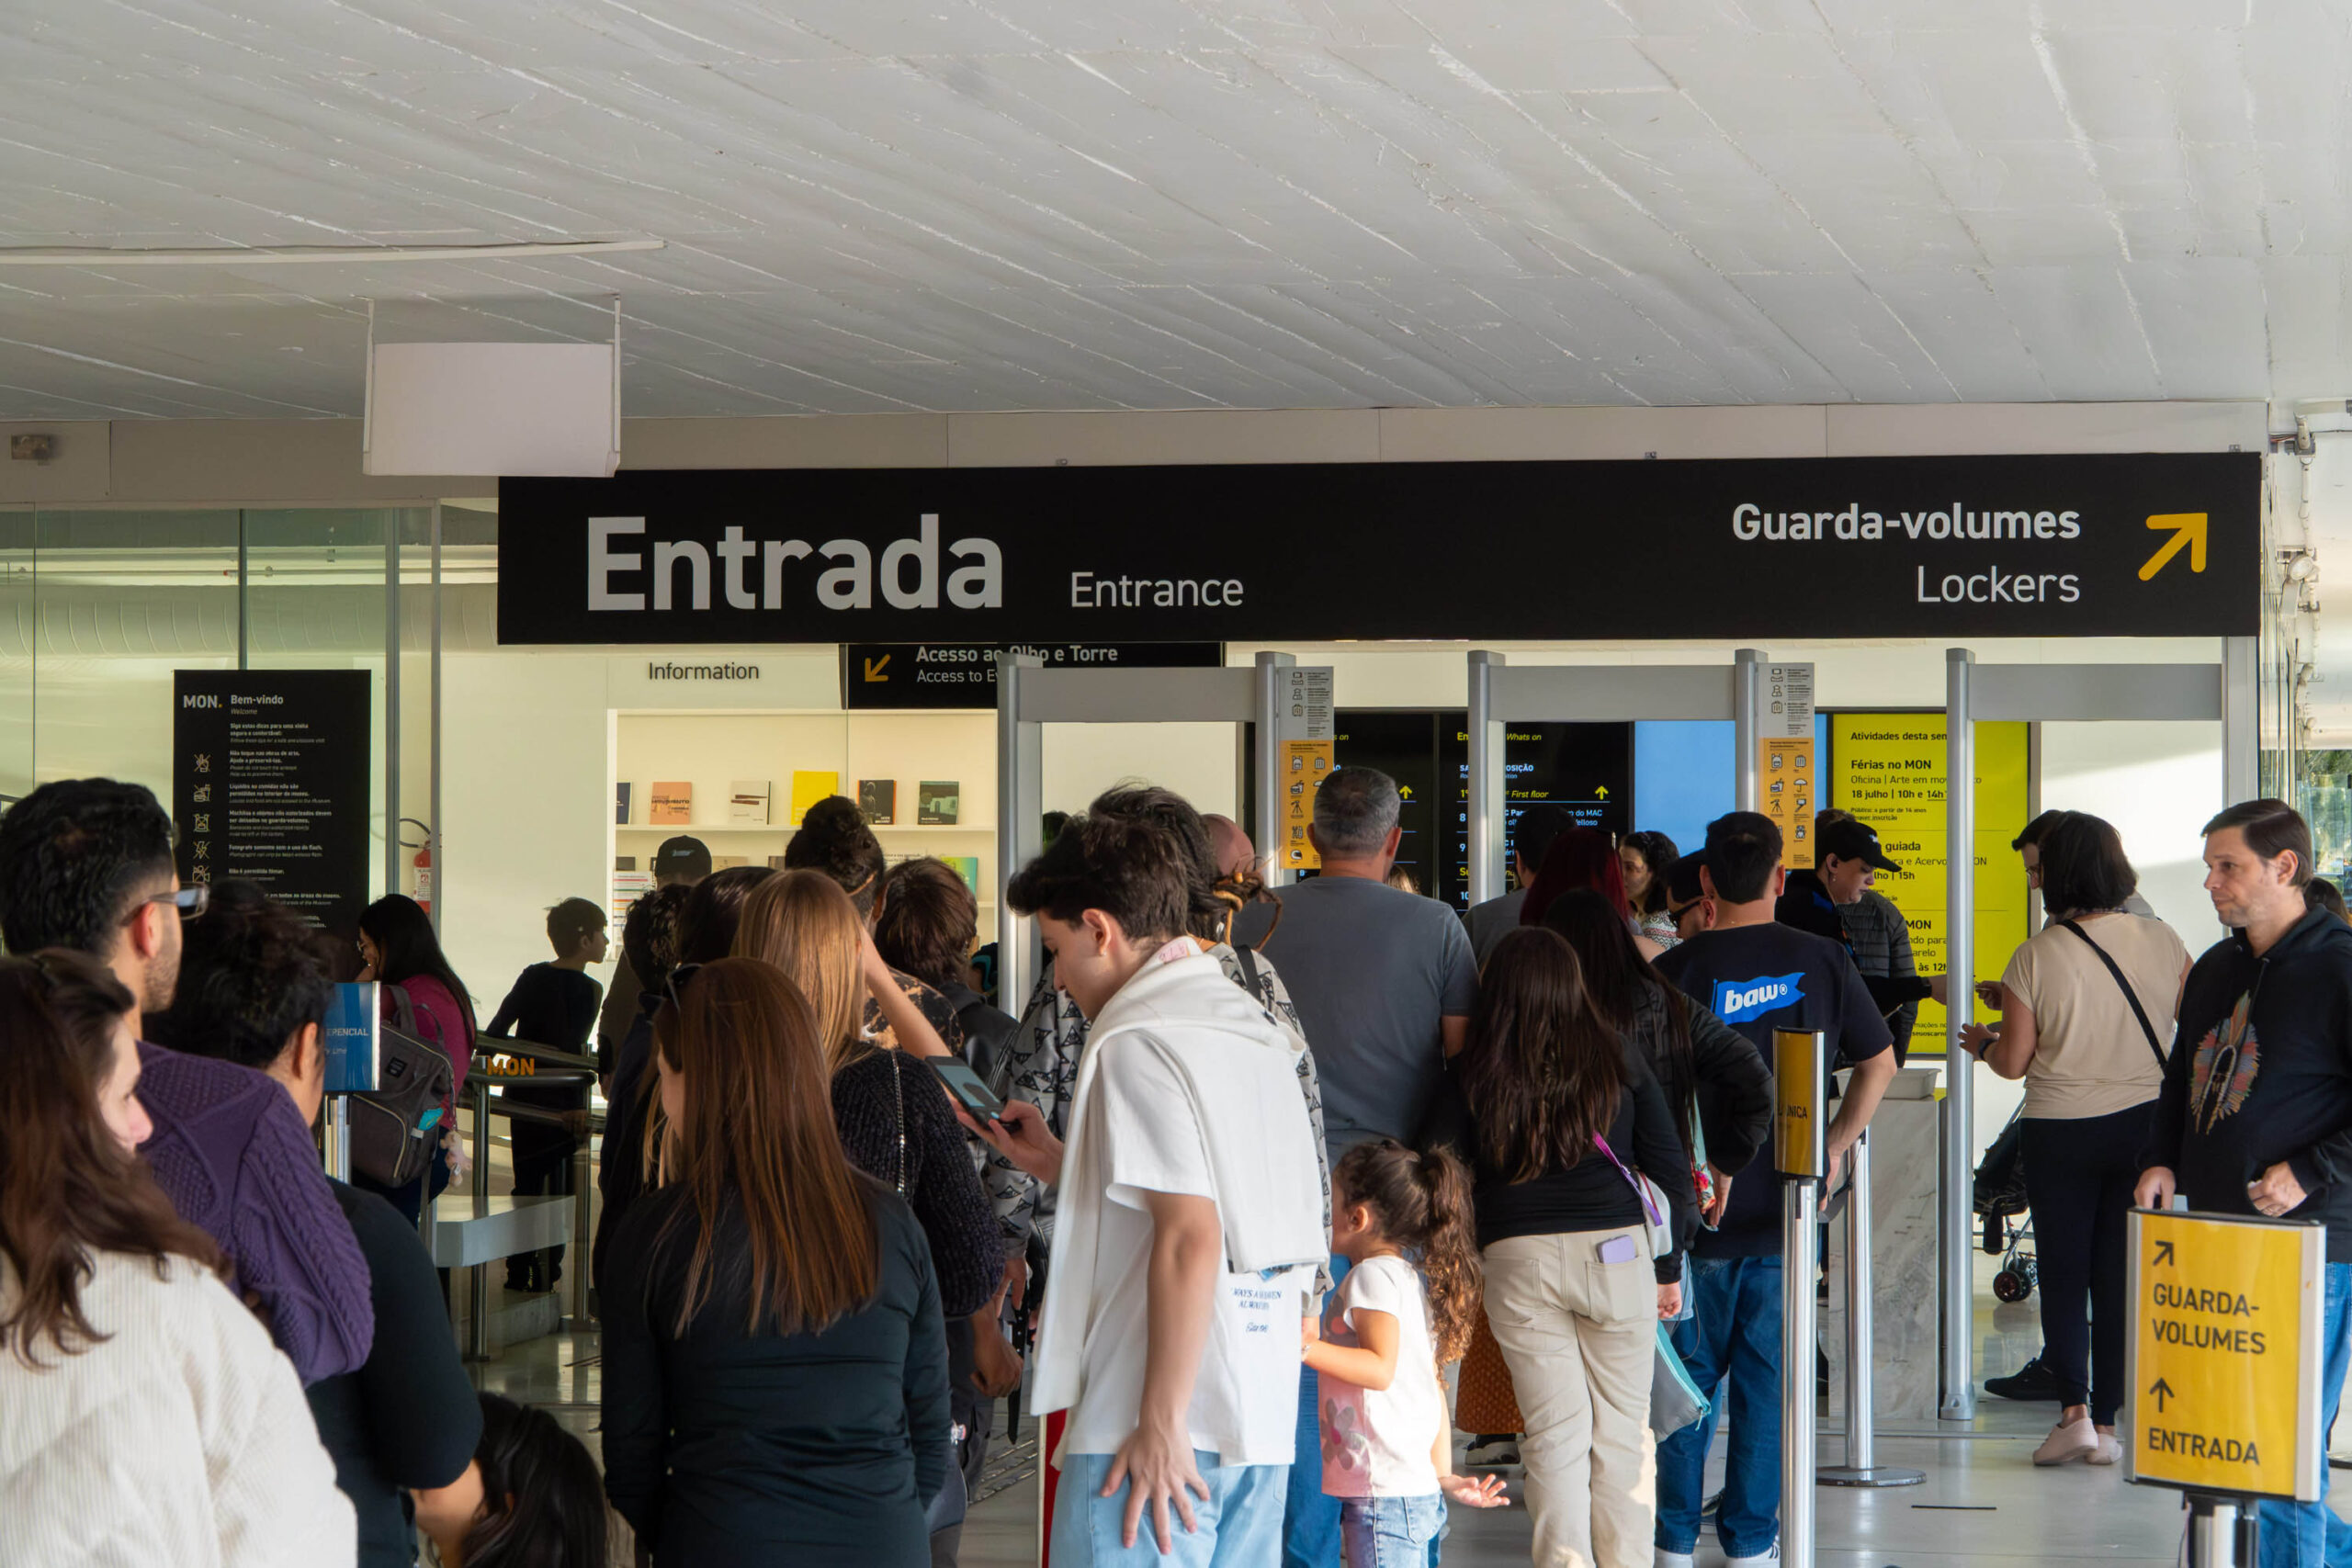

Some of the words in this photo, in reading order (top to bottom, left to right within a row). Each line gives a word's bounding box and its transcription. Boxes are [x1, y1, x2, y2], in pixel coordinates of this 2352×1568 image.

[1733, 502, 2081, 541] Guarda-volumes
[587, 513, 1003, 612] Entrada
[1070, 570, 1244, 607] Entrance
[1917, 565, 2080, 603] Lockers
[916, 646, 978, 662] Acesso
[1054, 650, 1065, 661] e
[1069, 645, 1118, 661] Torre
[648, 661, 760, 682] Information
[917, 670, 965, 682] Access
[968, 671, 983, 682] to
[231, 694, 284, 705] Bem-vindo
[1506, 732, 1531, 740] Whats
[1850, 732, 1899, 740] Atividades
[1903, 732, 1928, 740] desta
[1505, 763, 1534, 773] OSIÇÃO
[1850, 760, 1884, 770] Férias
[1905, 760, 1931, 770] MON
[1850, 775, 1882, 784] Oficina
[1531, 790, 1549, 798] floor
[1851, 790, 1862, 798] 18
[1865, 790, 1888, 799] julho
[1898, 790, 1915, 798] 10h
[1459, 813, 1466, 822] 8
[1459, 843, 1465, 852] 9
[1885, 841, 1921, 852] guiada
[1915, 857, 1948, 865] Acervo
[1912, 949, 1936, 957] arelo
[1918, 963, 1929, 971] às
[486, 1057, 536, 1077] MON
[2153, 1283, 2260, 1317] GUARDA-
[2152, 1318, 2267, 1355] VOLUMES
[2148, 1427, 2261, 1466] ENTRADA
